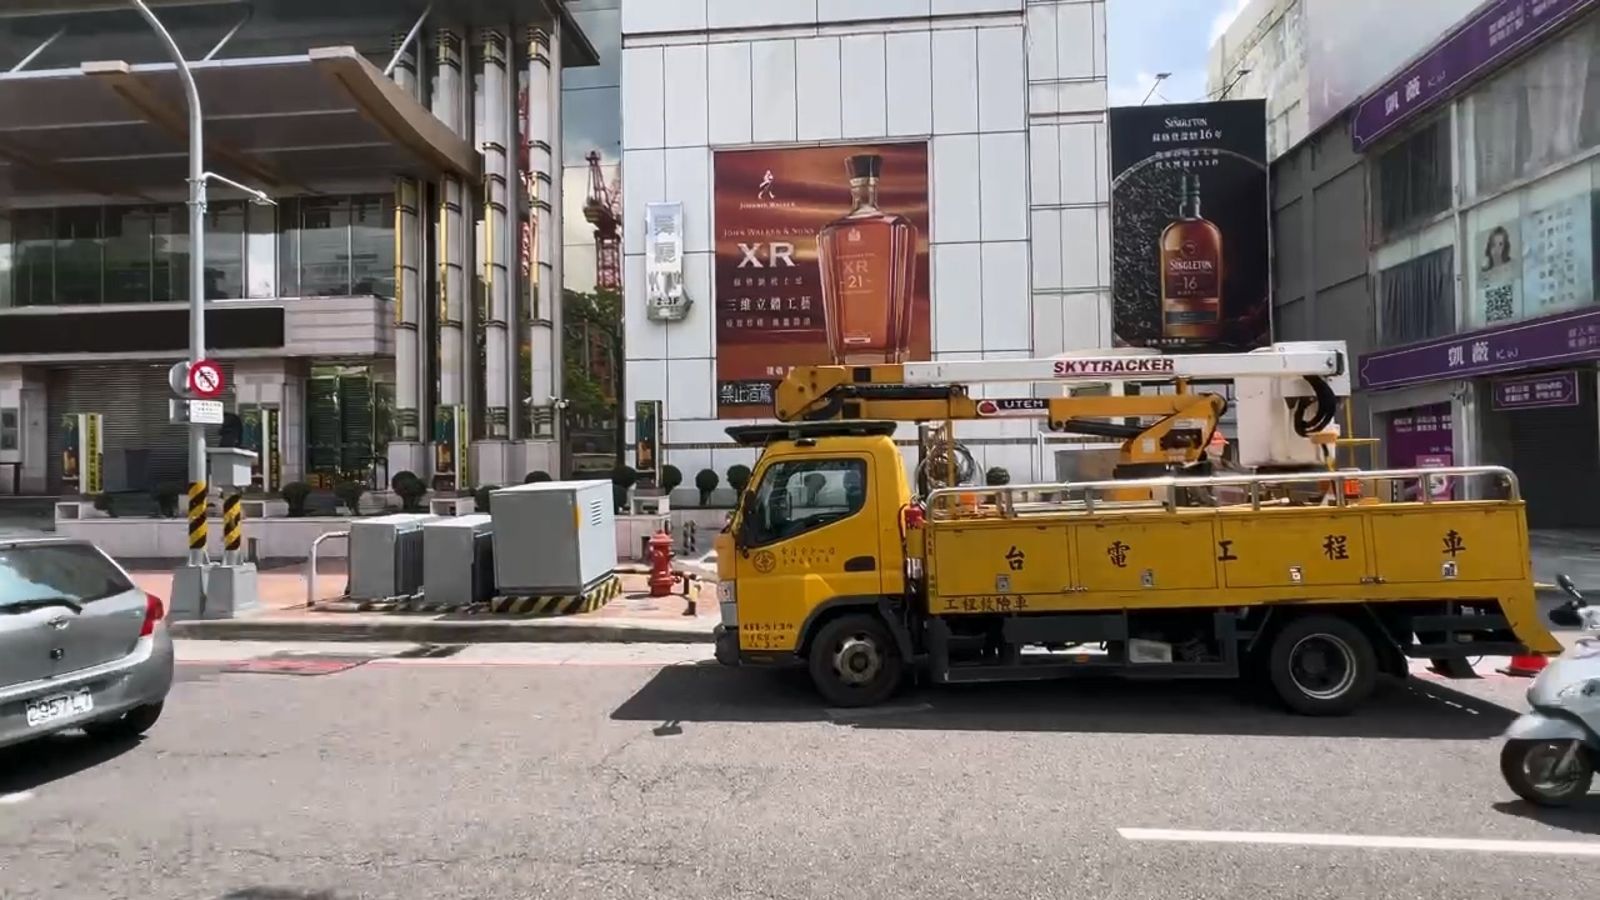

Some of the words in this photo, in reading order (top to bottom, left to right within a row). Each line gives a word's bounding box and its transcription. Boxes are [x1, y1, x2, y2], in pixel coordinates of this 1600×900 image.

[737, 242, 796, 268] XR
[843, 259, 869, 273] XR
[848, 275, 863, 288] 21
[1183, 276, 1198, 290] 16
[1448, 341, 1489, 366] 凱薇
[1054, 358, 1175, 374] SKYTRACKER
[1004, 399, 1044, 409] UTEM
